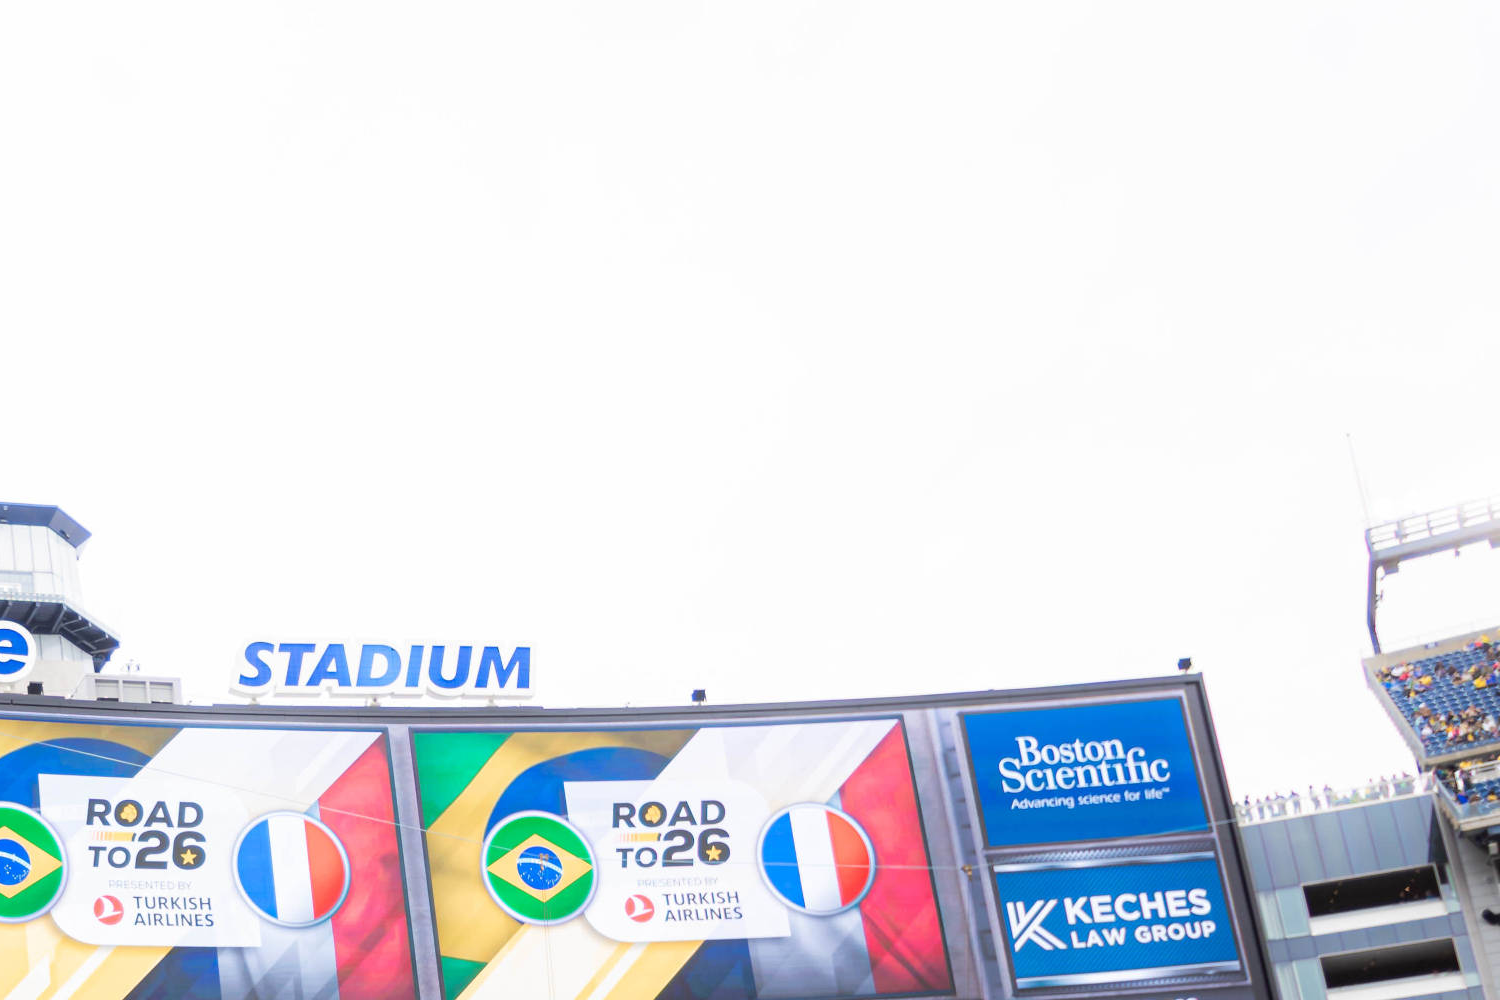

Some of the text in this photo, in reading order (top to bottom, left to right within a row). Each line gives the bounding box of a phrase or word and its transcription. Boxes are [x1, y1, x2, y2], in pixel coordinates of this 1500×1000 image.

[238, 640, 531, 690] STADIUM
[1015, 735, 1125, 767] Boston
[998, 746, 1171, 793] Scientific
[86, 798, 203, 828] ROAD
[612, 800, 725, 828] ROAD
[1011, 795, 1075, 810] Advancing
[1077, 793, 1120, 806] science
[1123, 790, 1141, 802] for
[88, 829, 206, 870] TO 26
[616, 828, 730, 868] TO 26
[108, 879, 191, 890] PRESENTED BY
[637, 876, 718, 888] PRESENTED BY
[133, 896, 211, 911] TURKISH
[662, 891, 739, 906] TURKISH
[1063, 888, 1212, 925] KECHES
[134, 912, 214, 927] AIRLINES
[664, 907, 743, 922] AIRLINES
[1070, 920, 1217, 949] LAW GROUP
